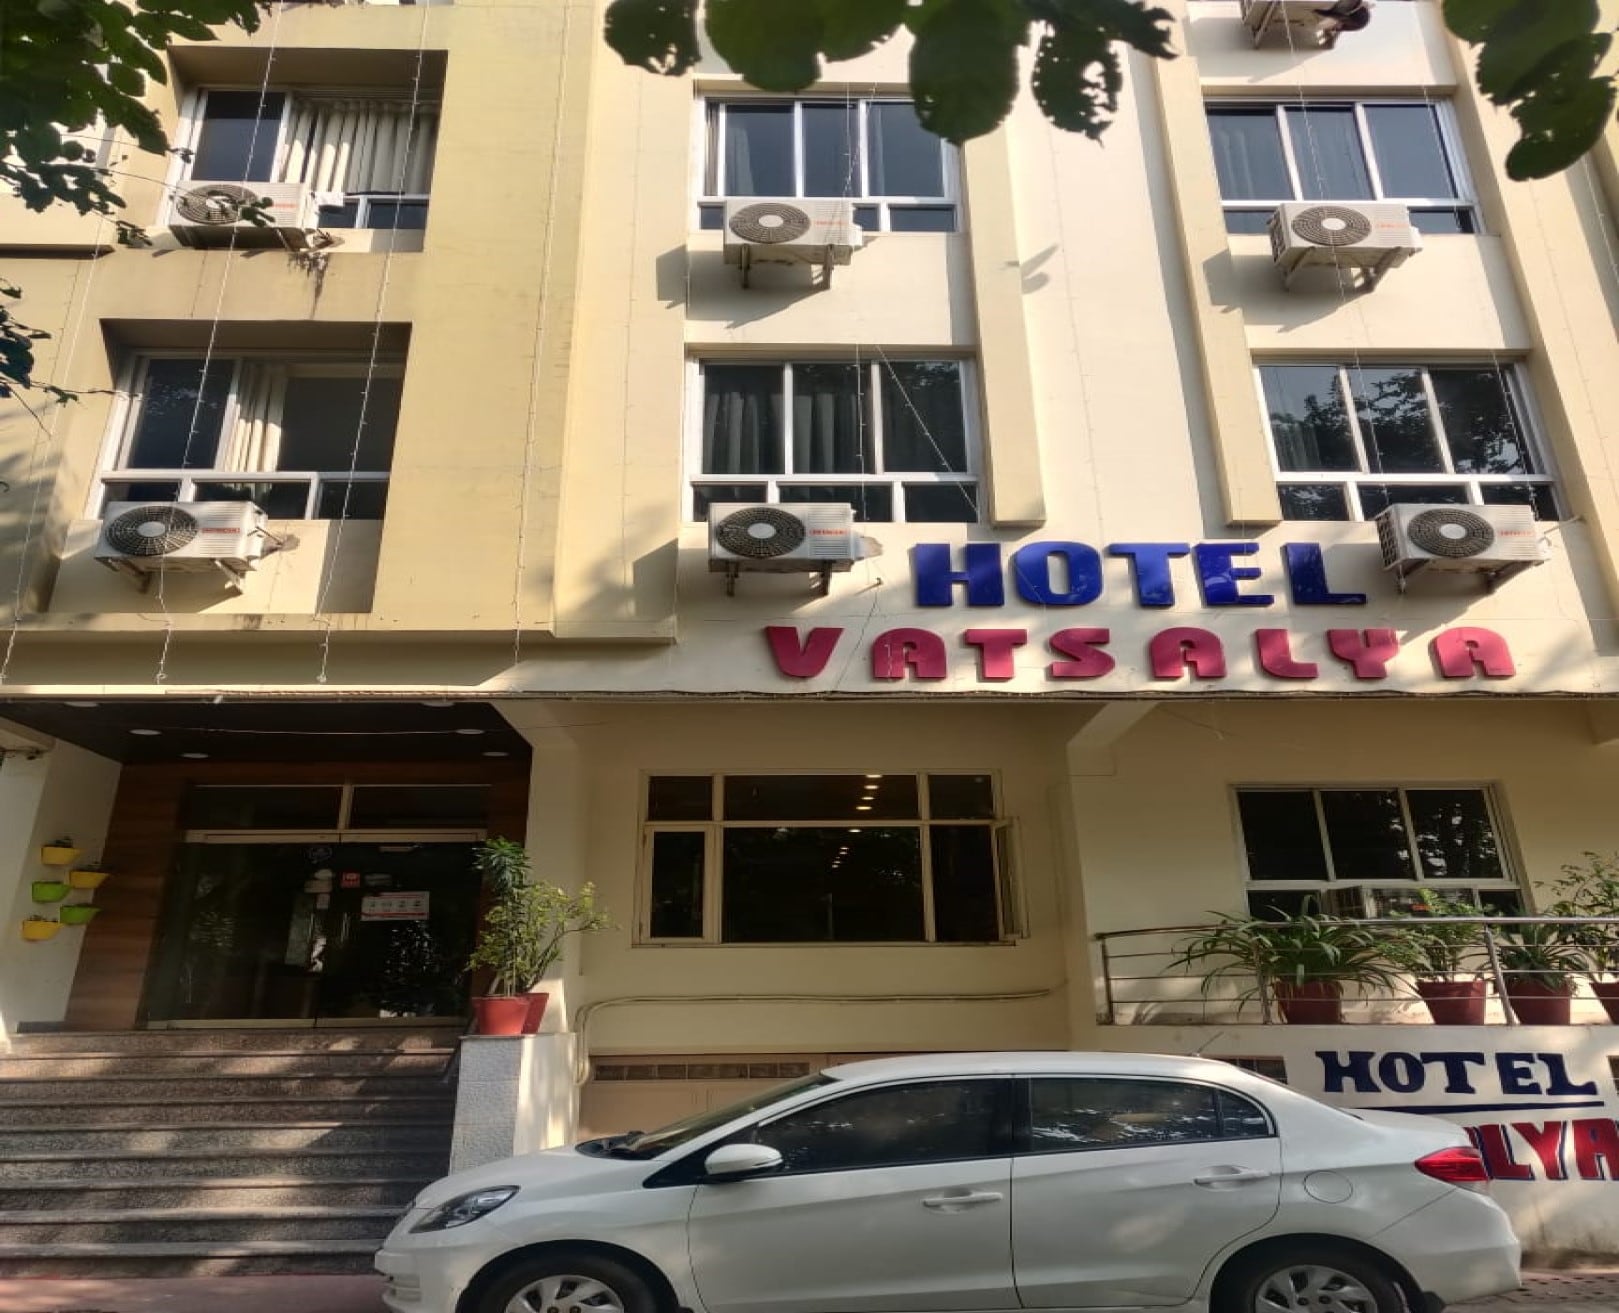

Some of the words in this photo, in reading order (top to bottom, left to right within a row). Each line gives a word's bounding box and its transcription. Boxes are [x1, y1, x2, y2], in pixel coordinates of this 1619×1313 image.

[916, 541, 1366, 607] HOTEL
[766, 626, 1514, 681] VATSALYA
[1316, 1051, 1598, 1094] HOTEL
[1463, 1118, 1619, 1181] LYA
